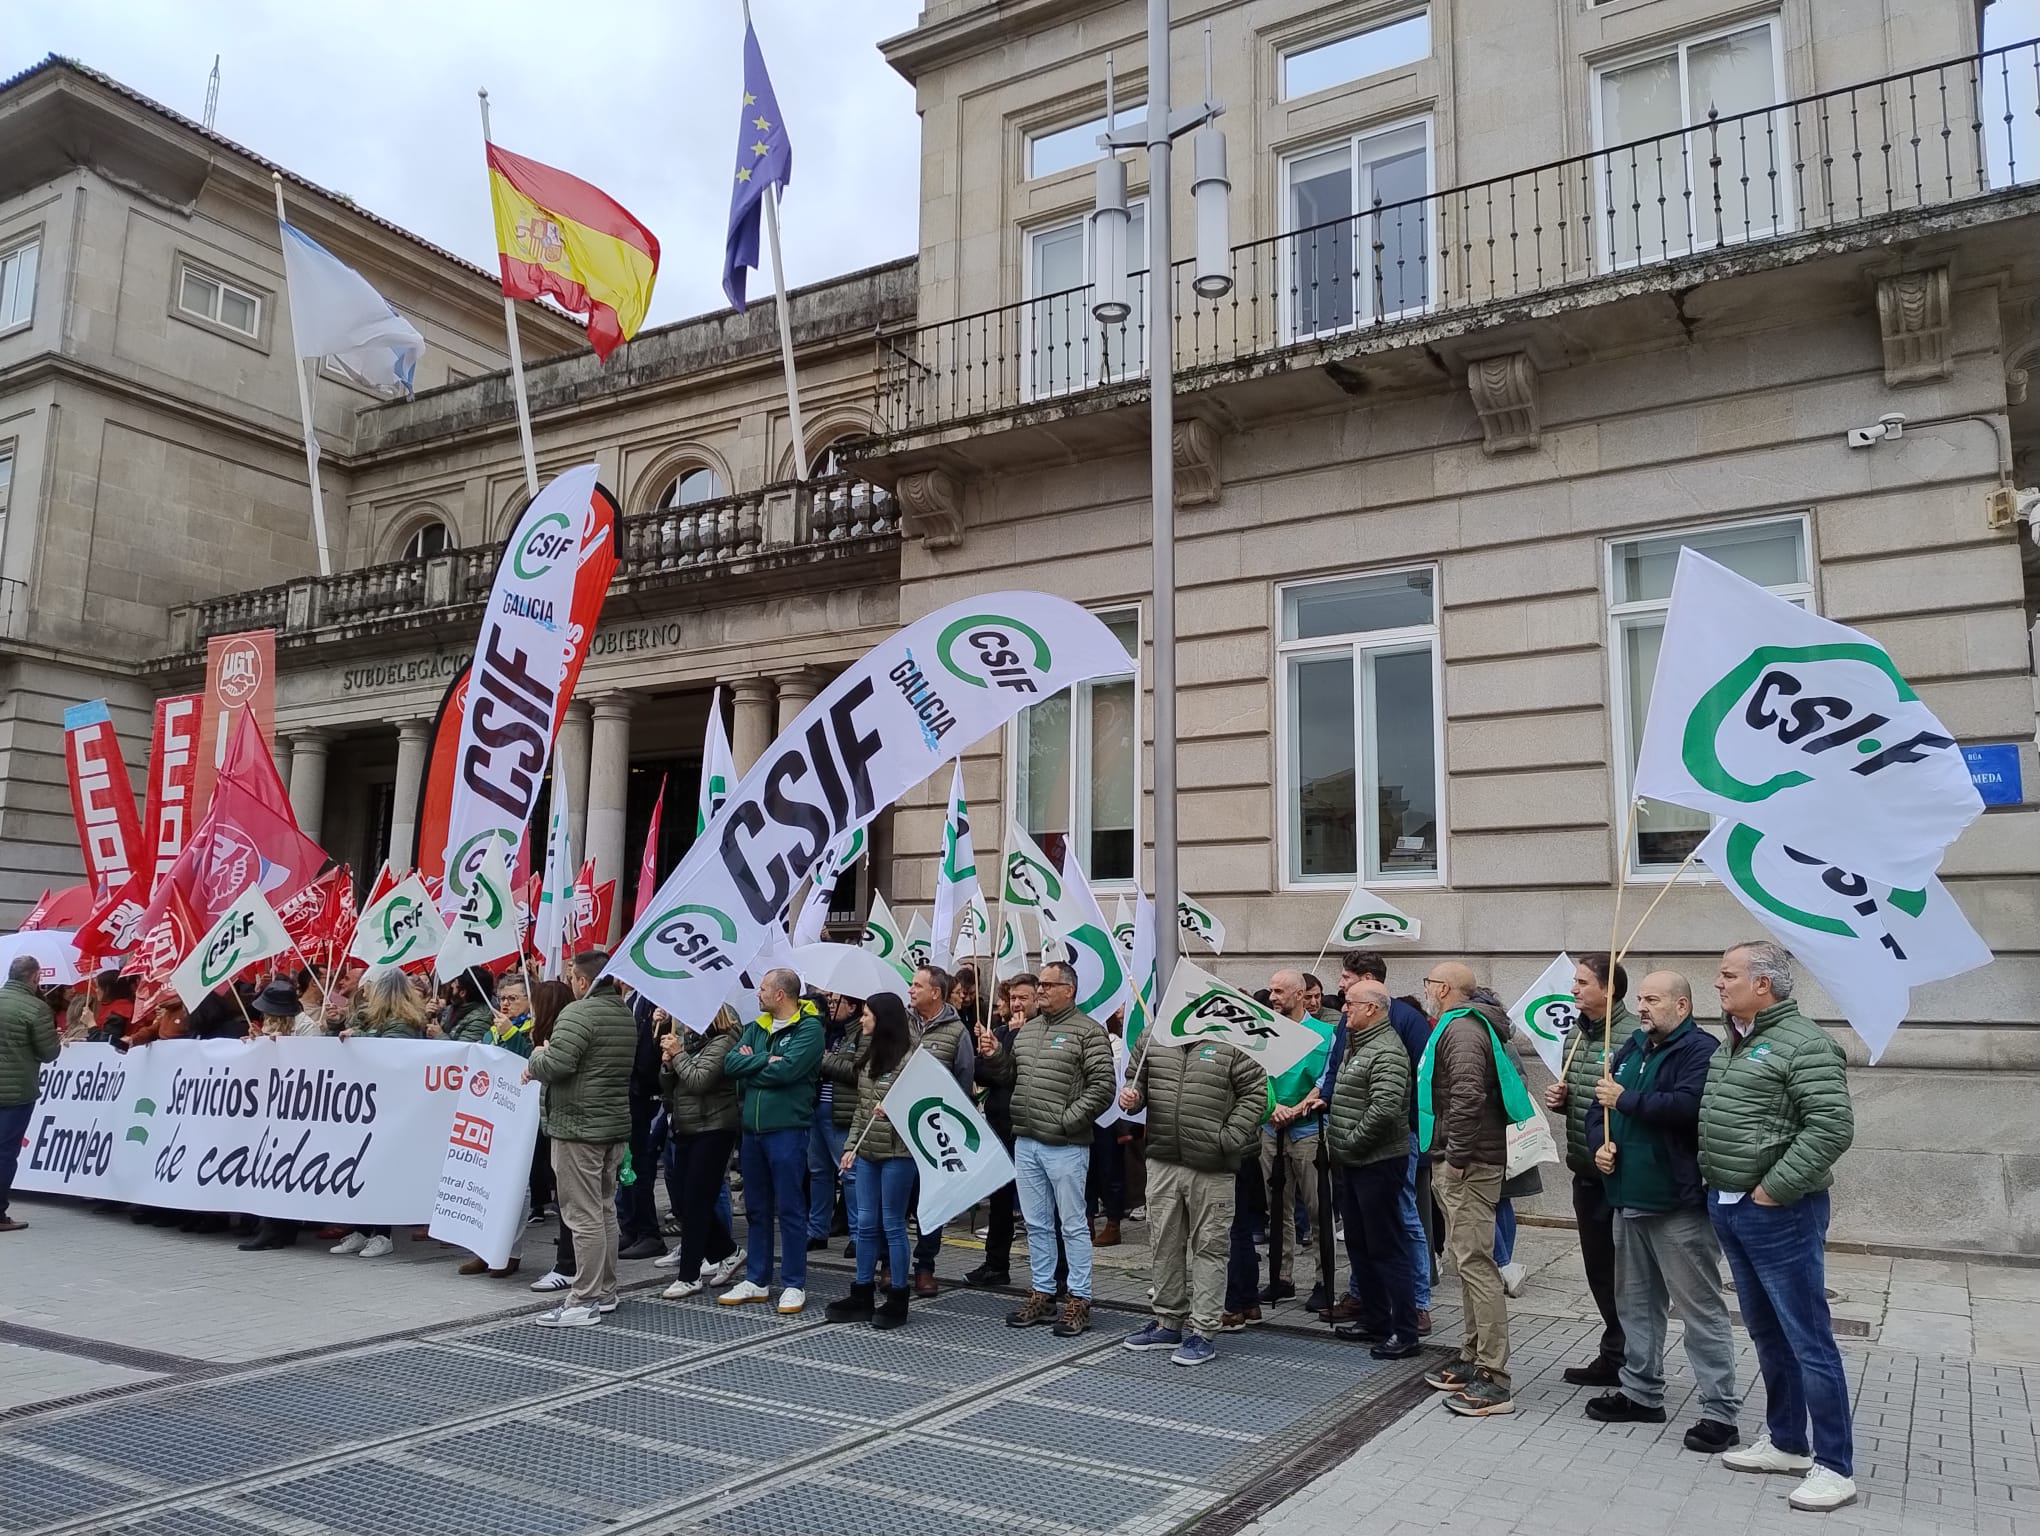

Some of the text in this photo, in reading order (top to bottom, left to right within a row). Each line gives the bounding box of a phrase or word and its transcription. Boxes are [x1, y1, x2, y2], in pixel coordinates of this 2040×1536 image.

[526, 531, 574, 562] CSIF
[503, 592, 554, 623] GALICIA
[587, 623, 682, 657] OBIERNO
[222, 650, 255, 677] UGT
[968, 631, 1038, 695] CSIF
[463, 622, 555, 821] CSIF
[889, 658, 958, 741] GALICIA
[1968, 752, 1982, 761] RÚA
[1971, 772, 2003, 784] MEDA
[717, 676, 884, 926] CSIF
[656, 922, 734, 973] CSIF
[38, 1061, 72, 1106] ejor
[166, 1066, 377, 1125] Servicios Públicos
[30, 1115, 113, 1184] Empleo
[154, 1122, 373, 1199] de calidad
[447, 1147, 488, 1169] pública
[440, 1175, 465, 1189] ntral
